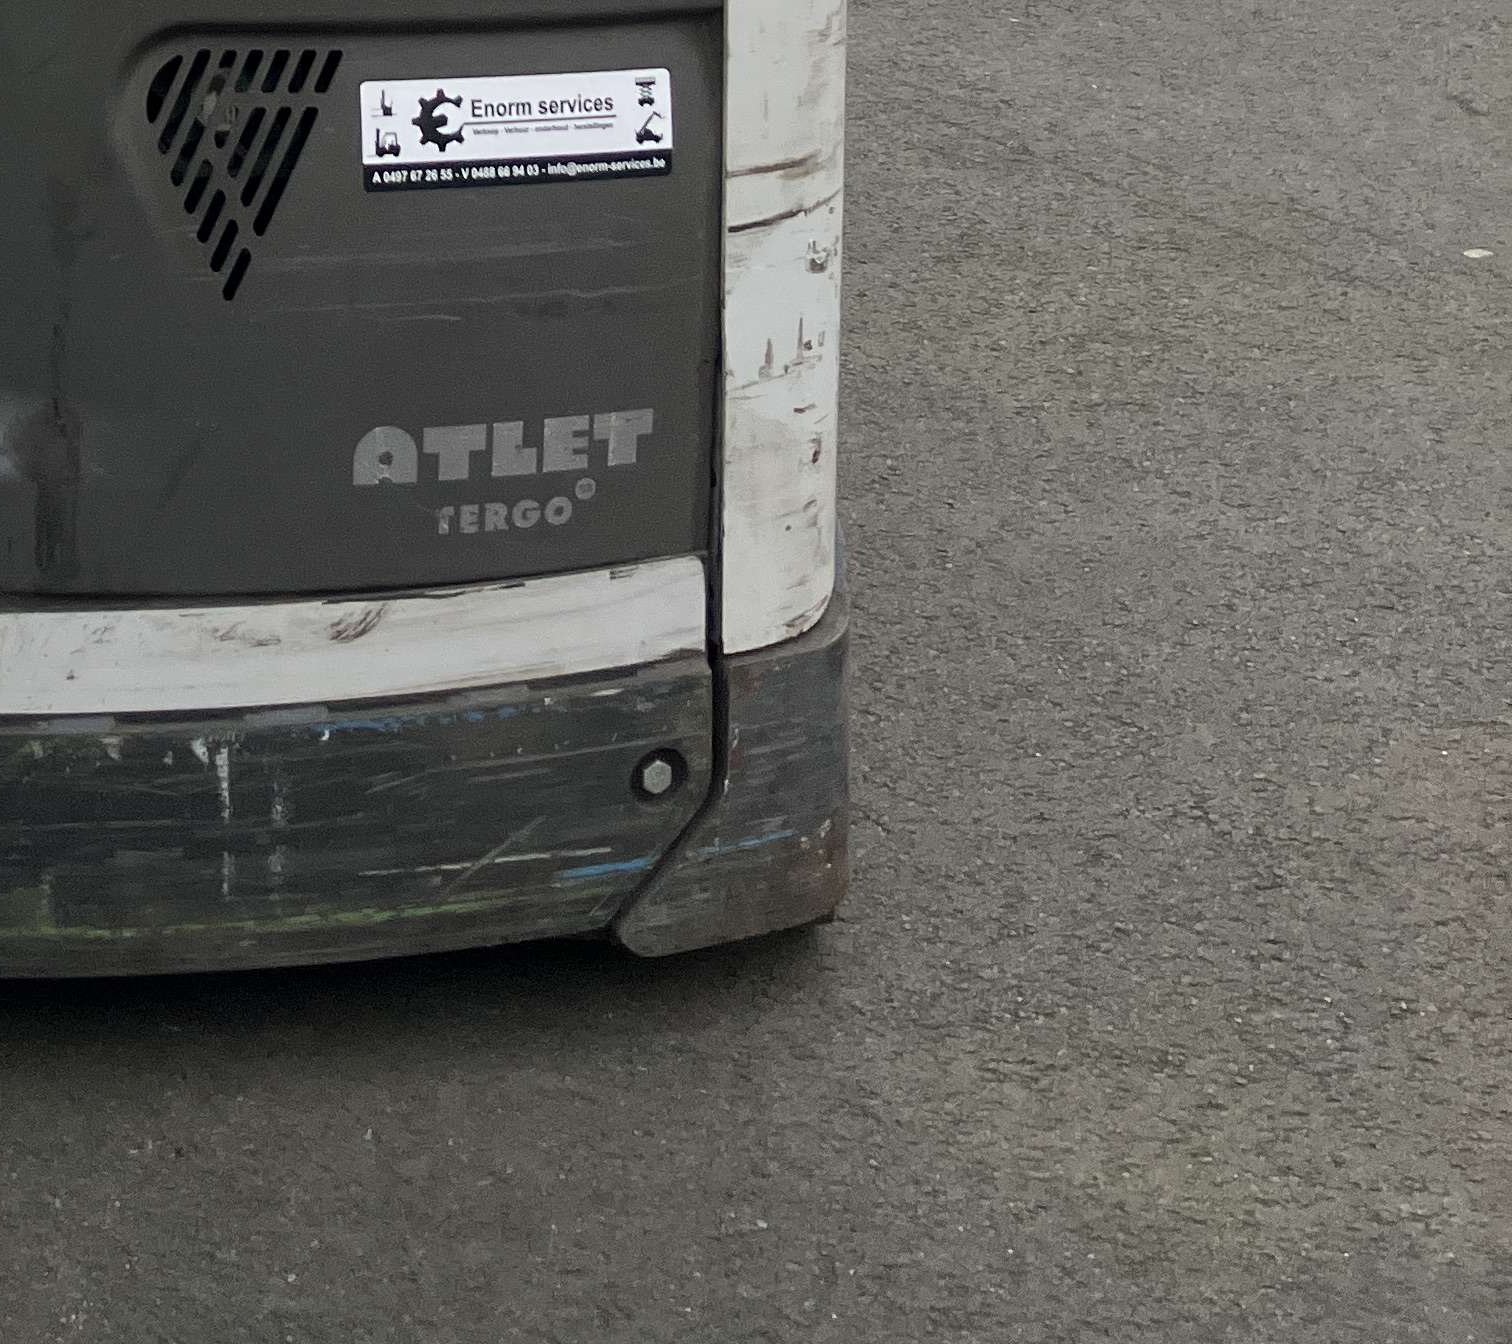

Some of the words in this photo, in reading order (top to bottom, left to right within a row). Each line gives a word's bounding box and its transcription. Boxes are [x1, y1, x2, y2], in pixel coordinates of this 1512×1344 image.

[470, 98, 532, 119] Enorm
[537, 93, 614, 116] services
[372, 171, 382, 184] A
[461, 167, 470, 180] V
[548, 156, 666, 176] info@enorm-services.be
[353, 408, 654, 485] ATLET
